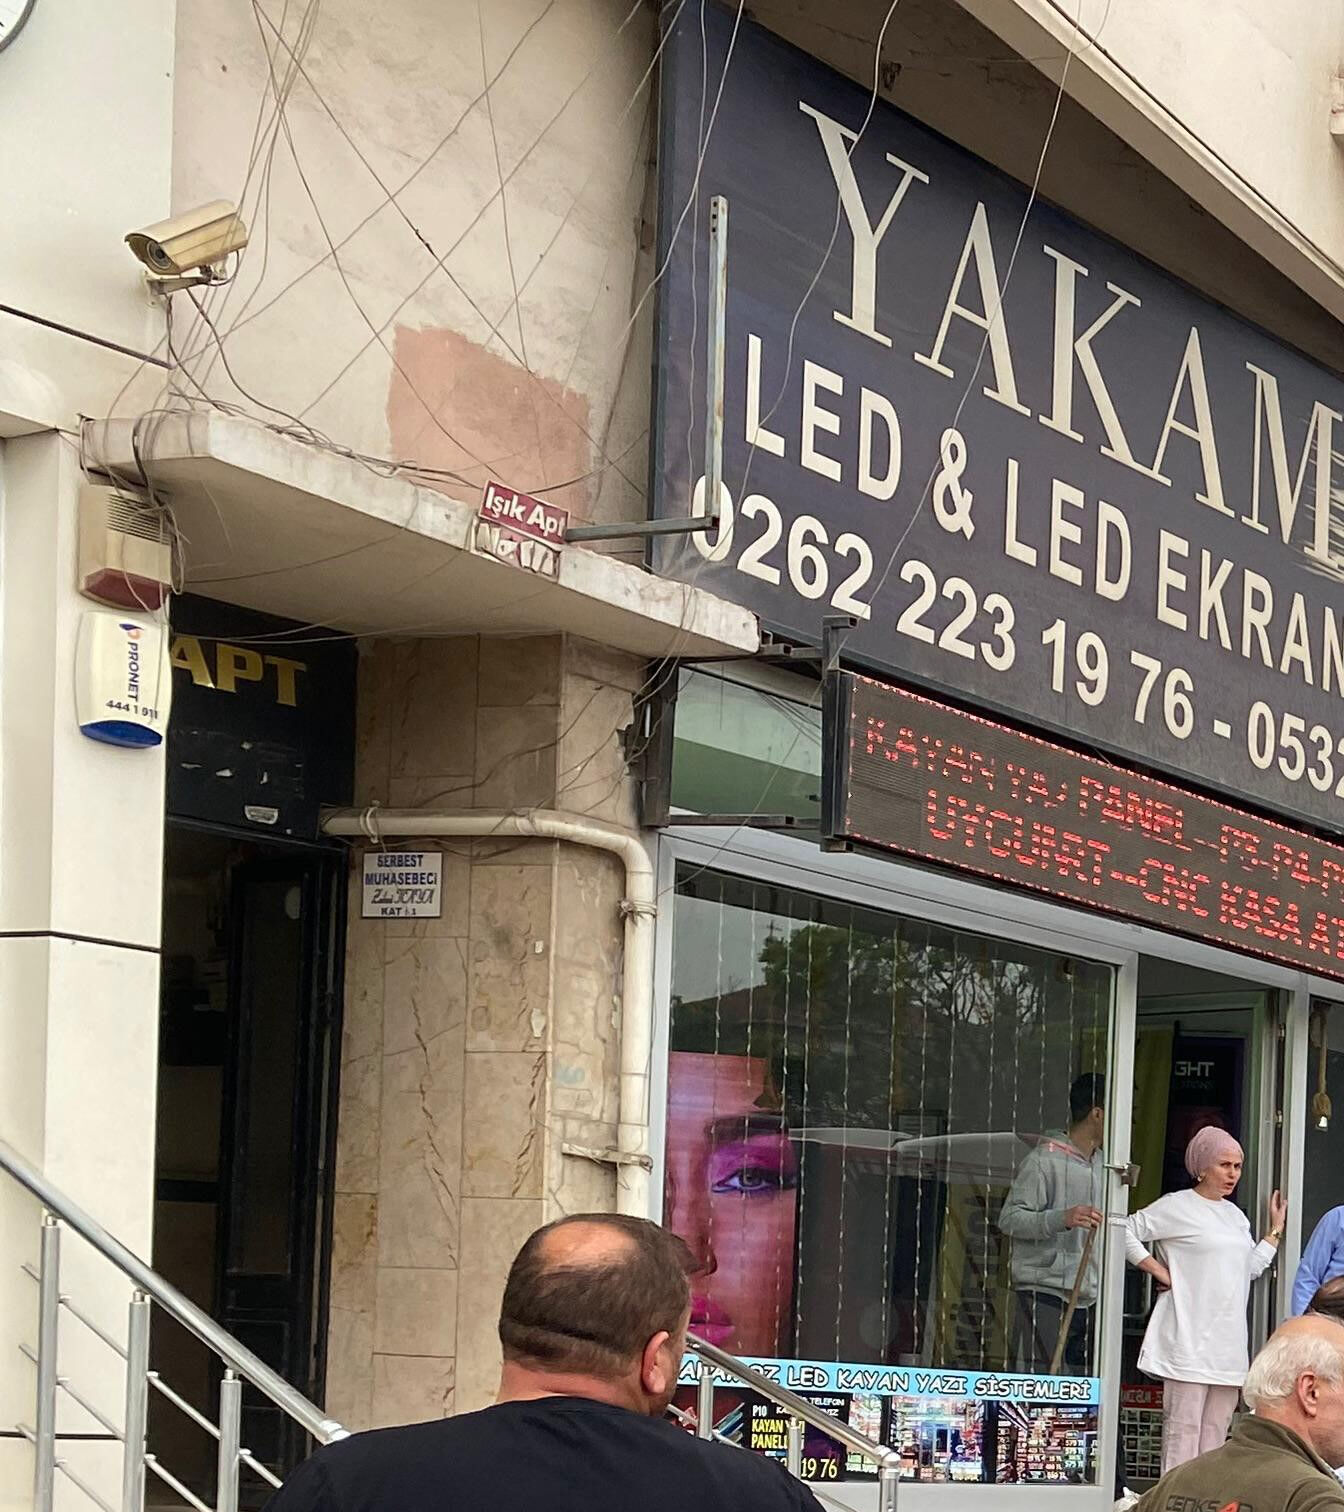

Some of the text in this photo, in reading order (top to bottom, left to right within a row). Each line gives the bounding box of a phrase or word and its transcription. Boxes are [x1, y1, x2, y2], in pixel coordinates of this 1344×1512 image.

[745, 333, 902, 502] LED
[931, 427, 975, 542] &
[1005, 456, 1132, 602] LED
[691, 474, 875, 620] 0262
[896, 558, 1017, 674] 223
[1040, 618, 1111, 707] 19
[1130, 650, 1196, 740] 76
[127, 641, 140, 701] PRONET
[105, 699, 130, 713] 444
[376, 854, 424, 868] SERBEST
[787, 1365, 829, 1388] LED
[837, 1367, 909, 1392] KAYAN
[916, 1373, 967, 1394] YAZI
[974, 1374, 1091, 1400] SİSTEMLERİ
[752, 1405, 768, 1417] P10
[751, 1418, 784, 1434] KAYAN
[801, 1458, 817, 1479] 19
[820, 1458, 838, 1479] 76
